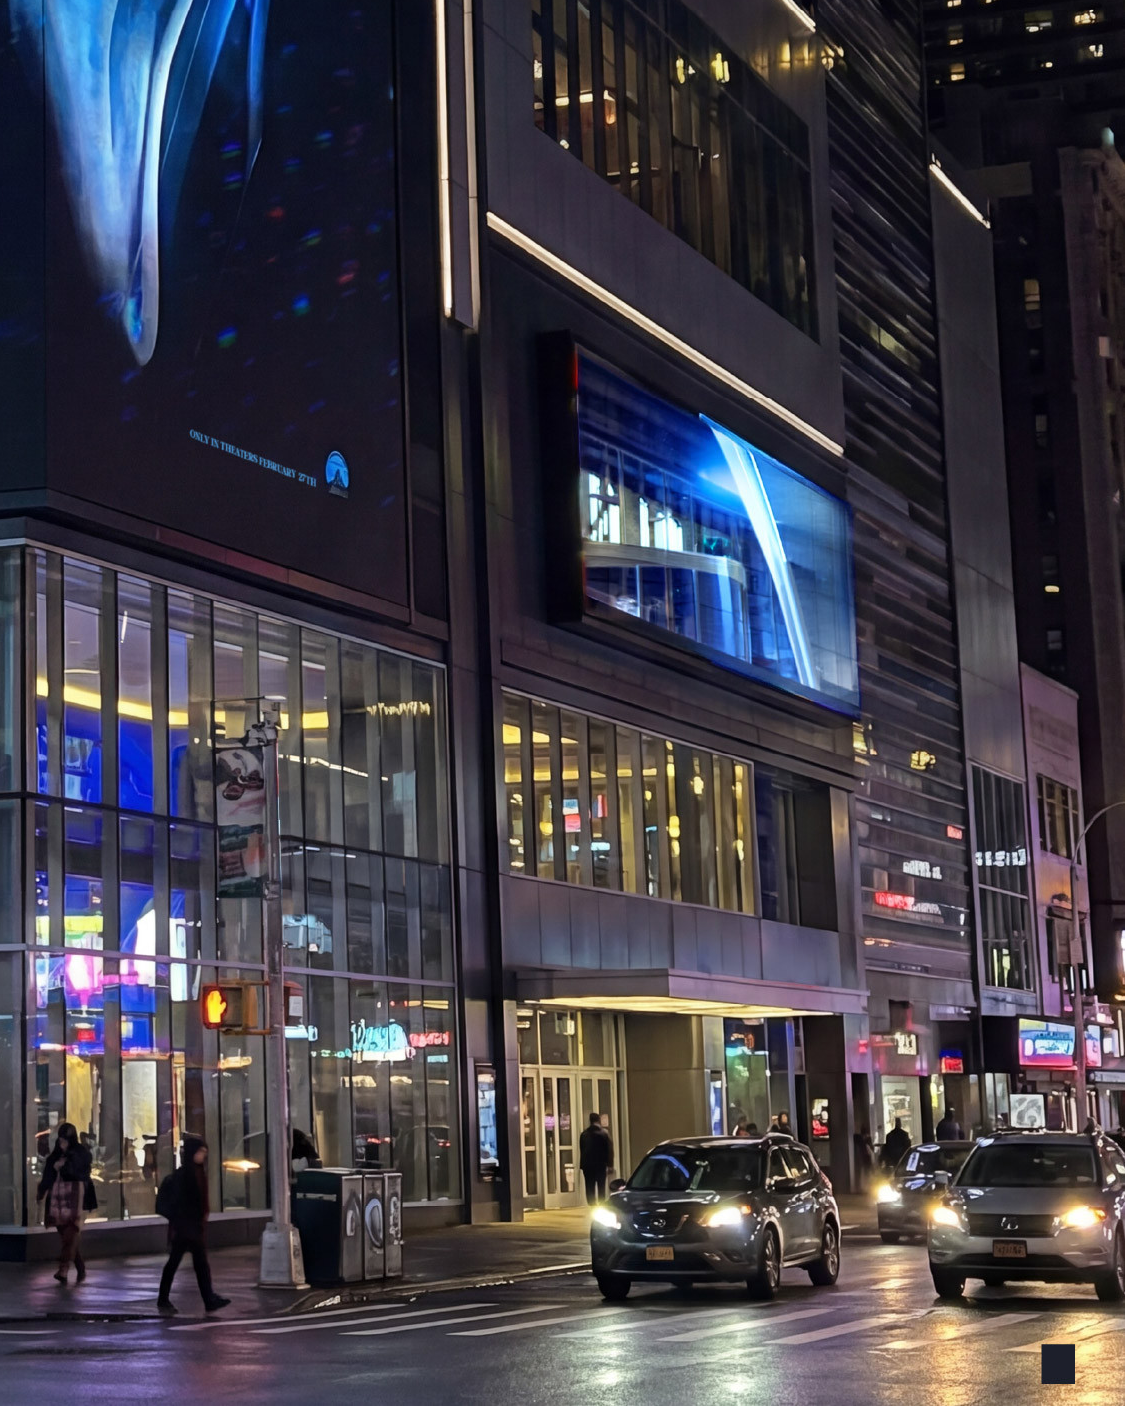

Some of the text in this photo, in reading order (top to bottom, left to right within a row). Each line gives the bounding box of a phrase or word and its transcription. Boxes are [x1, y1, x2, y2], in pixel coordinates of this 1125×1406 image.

[189, 429, 317, 488] ONLY IN THEATERS FEBRUARY 27TH
